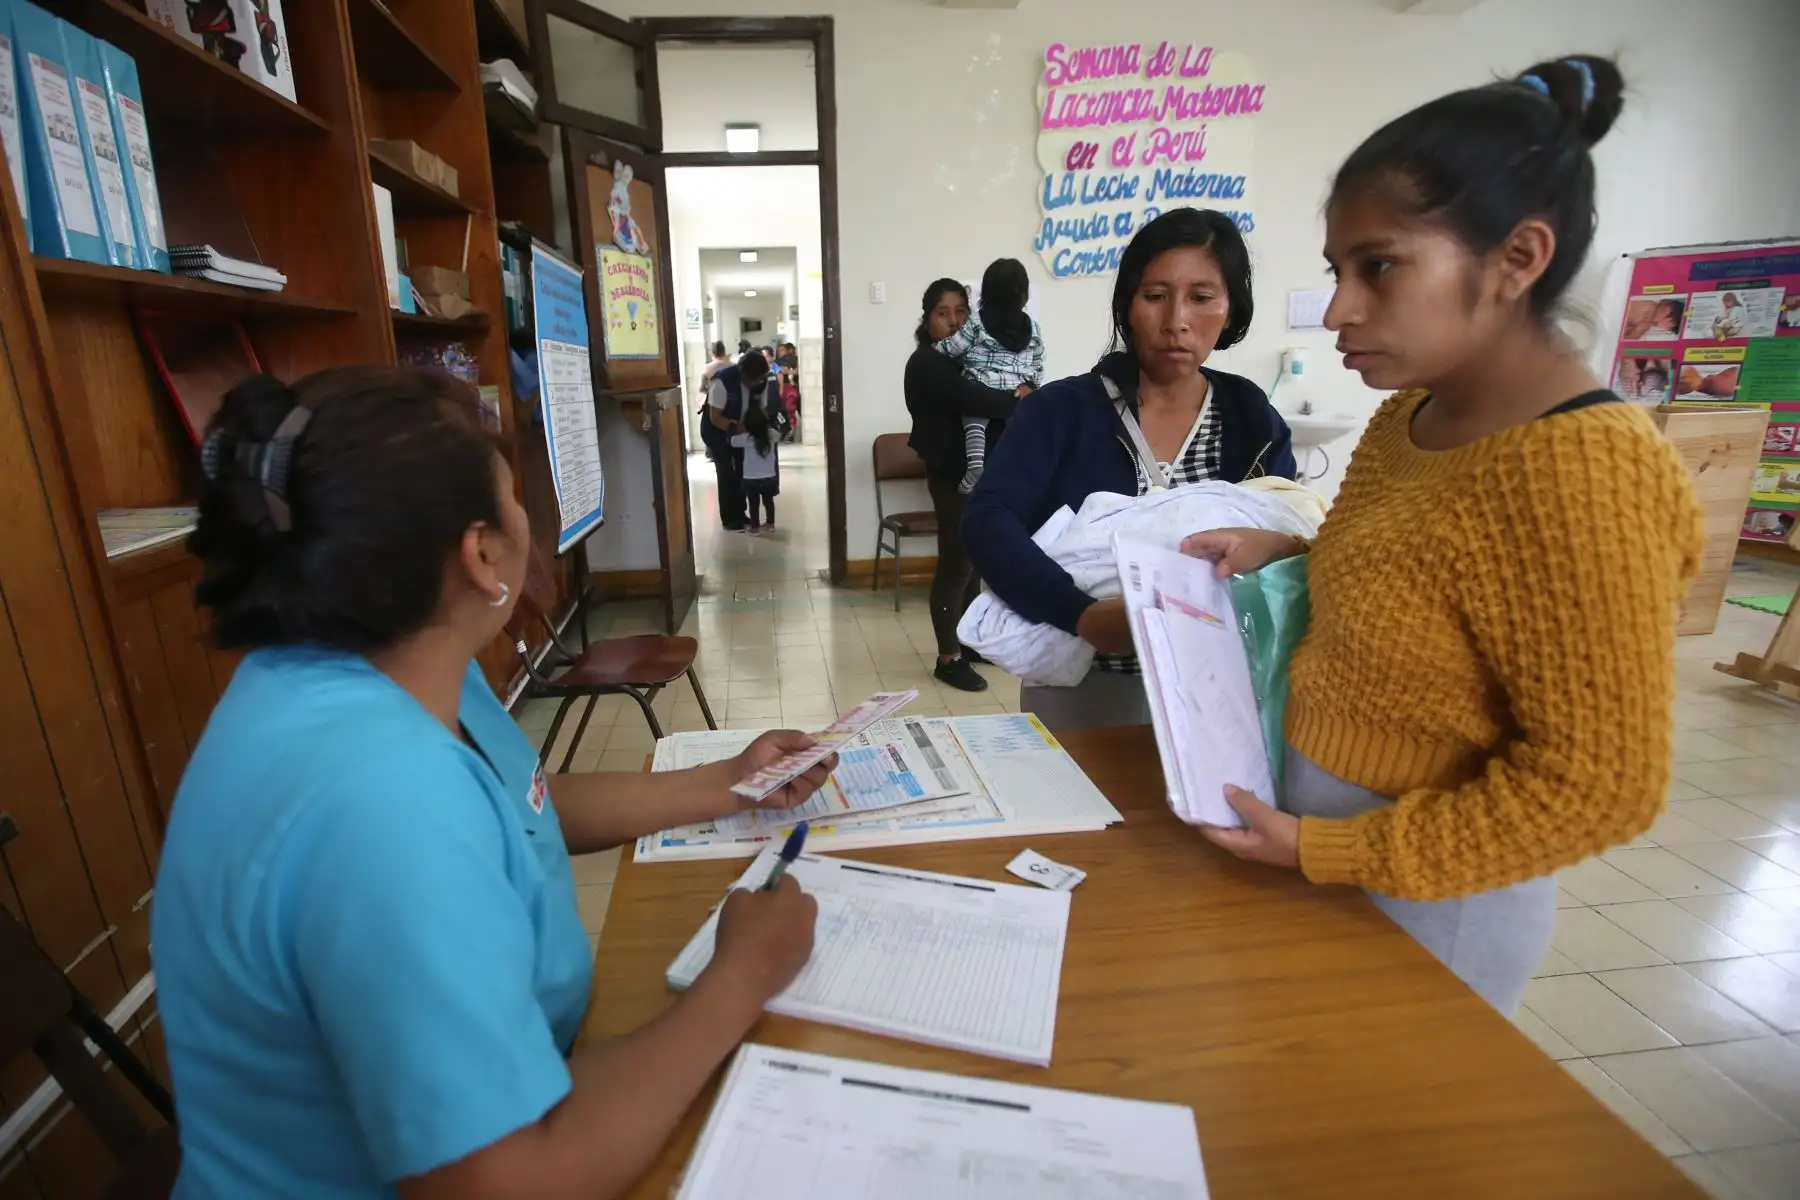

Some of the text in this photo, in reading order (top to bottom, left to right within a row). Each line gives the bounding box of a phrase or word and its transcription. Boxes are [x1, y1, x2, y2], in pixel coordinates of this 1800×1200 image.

[1044, 43, 1141, 86] Semana
[1146, 41, 1176, 78] de
[1153, 84, 1265, 122] Materna
[1066, 124, 1207, 171] en el Perú
[1081, 173, 1139, 204] Leche
[1146, 168, 1246, 202] Materna
[1114, 211, 1134, 237] a
